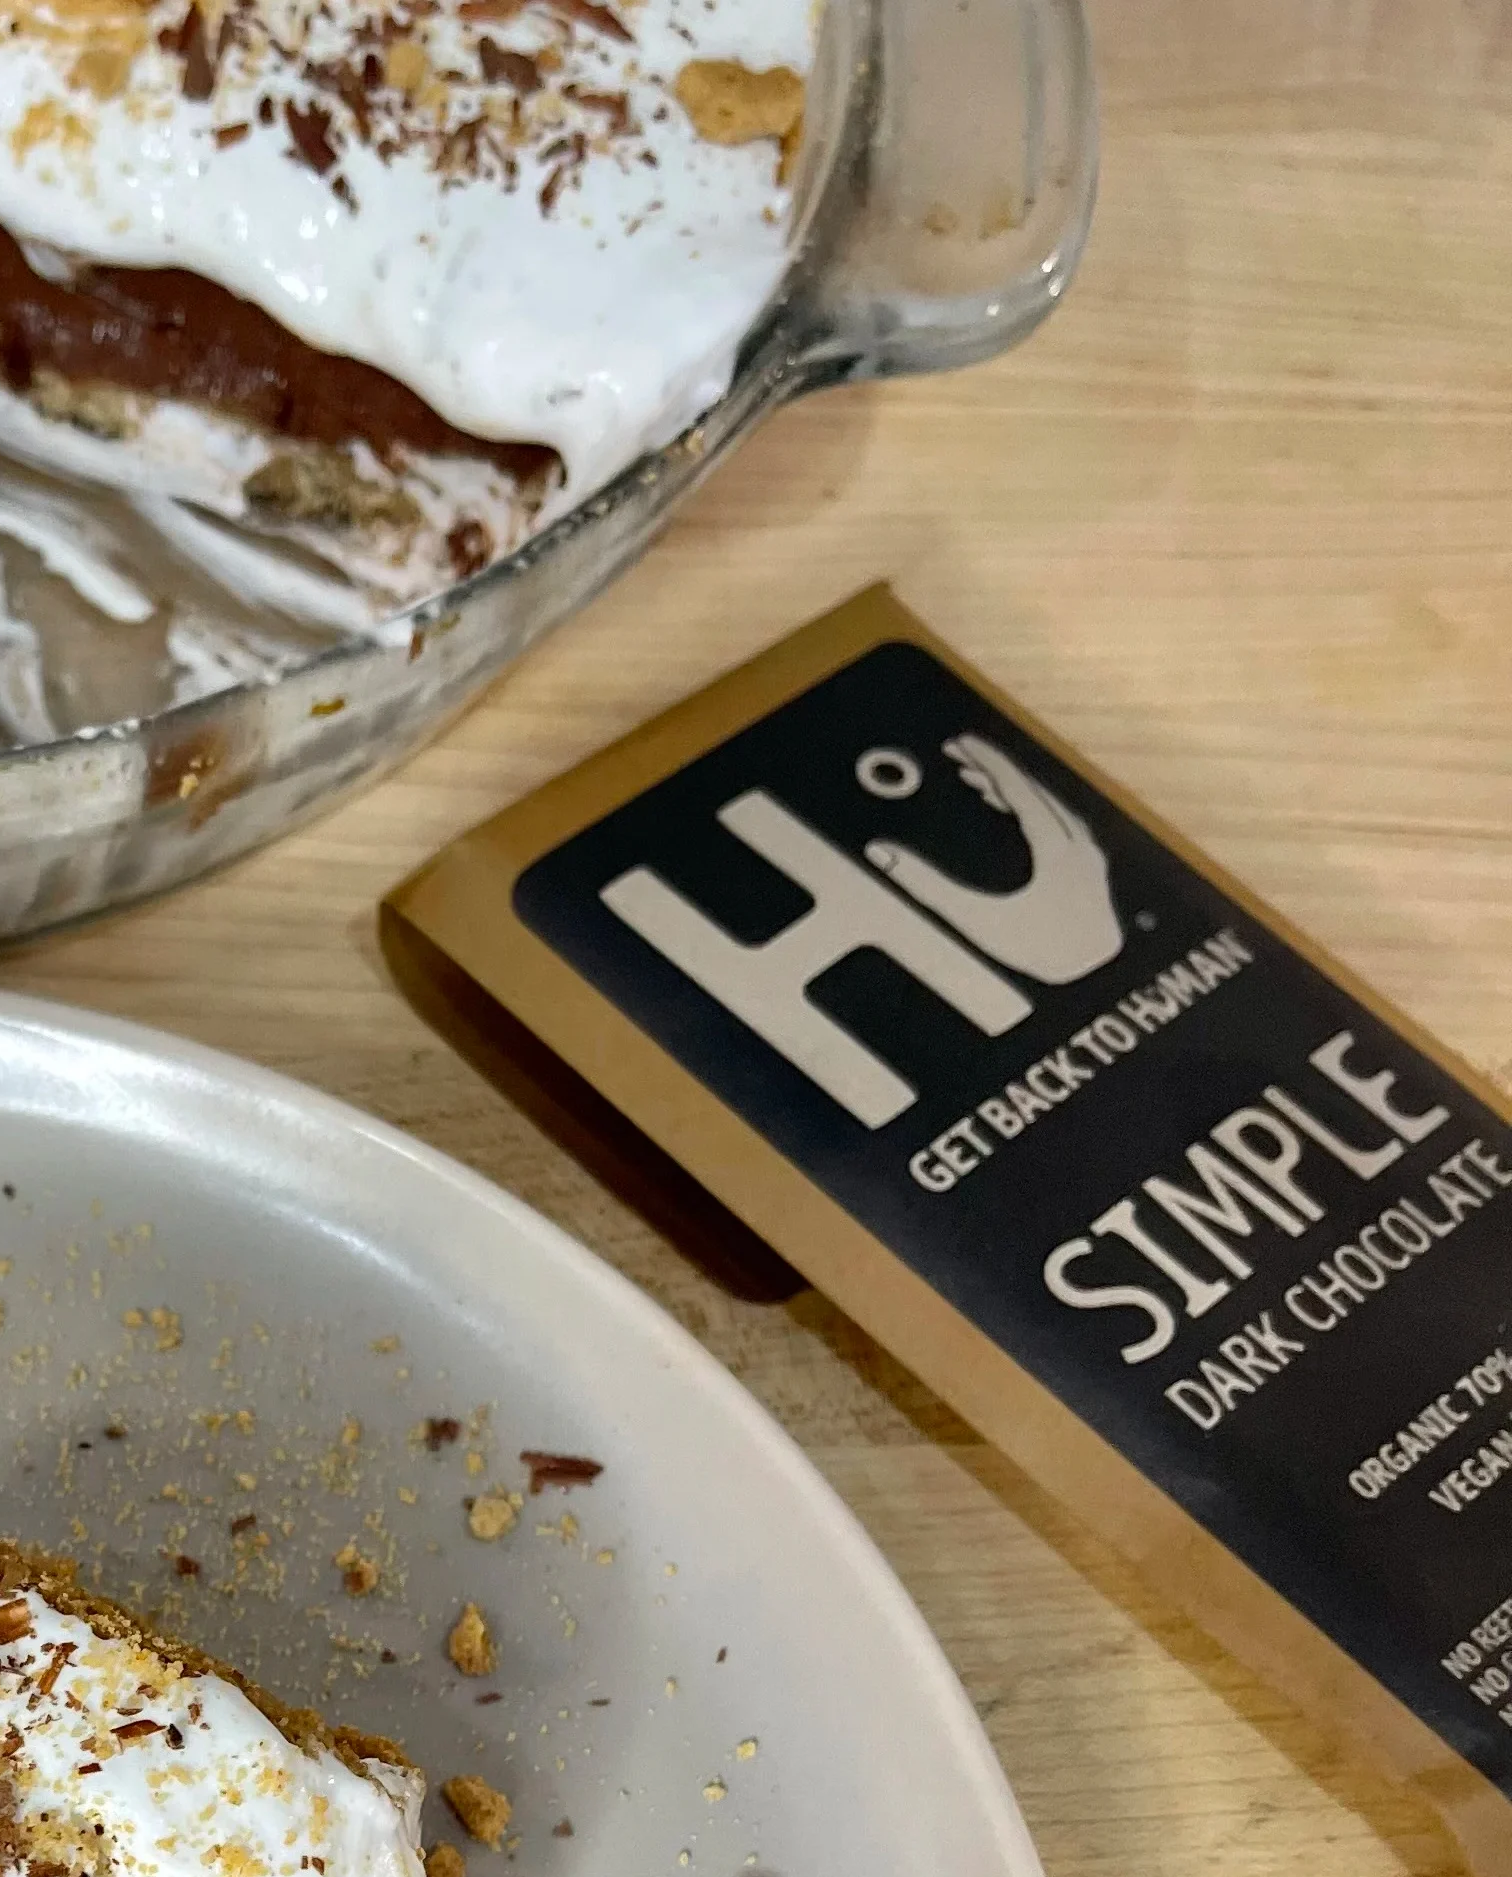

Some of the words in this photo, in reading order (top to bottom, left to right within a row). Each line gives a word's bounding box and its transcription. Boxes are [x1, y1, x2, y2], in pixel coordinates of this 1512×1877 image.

[909, 1116, 993, 1193] GET
[976, 1048, 1096, 1140] BACK
[1069, 1013, 1139, 1066] TO
[1043, 1029, 1452, 1365] SIMPLE
[1164, 1309, 1306, 1431] DARK
[1284, 1137, 1512, 1332] CHOCOLATE
[1348, 1393, 1471, 1499] ORGANIC
[1441, 1640, 1483, 1680] NO
[1469, 1666, 1511, 1706] NO
